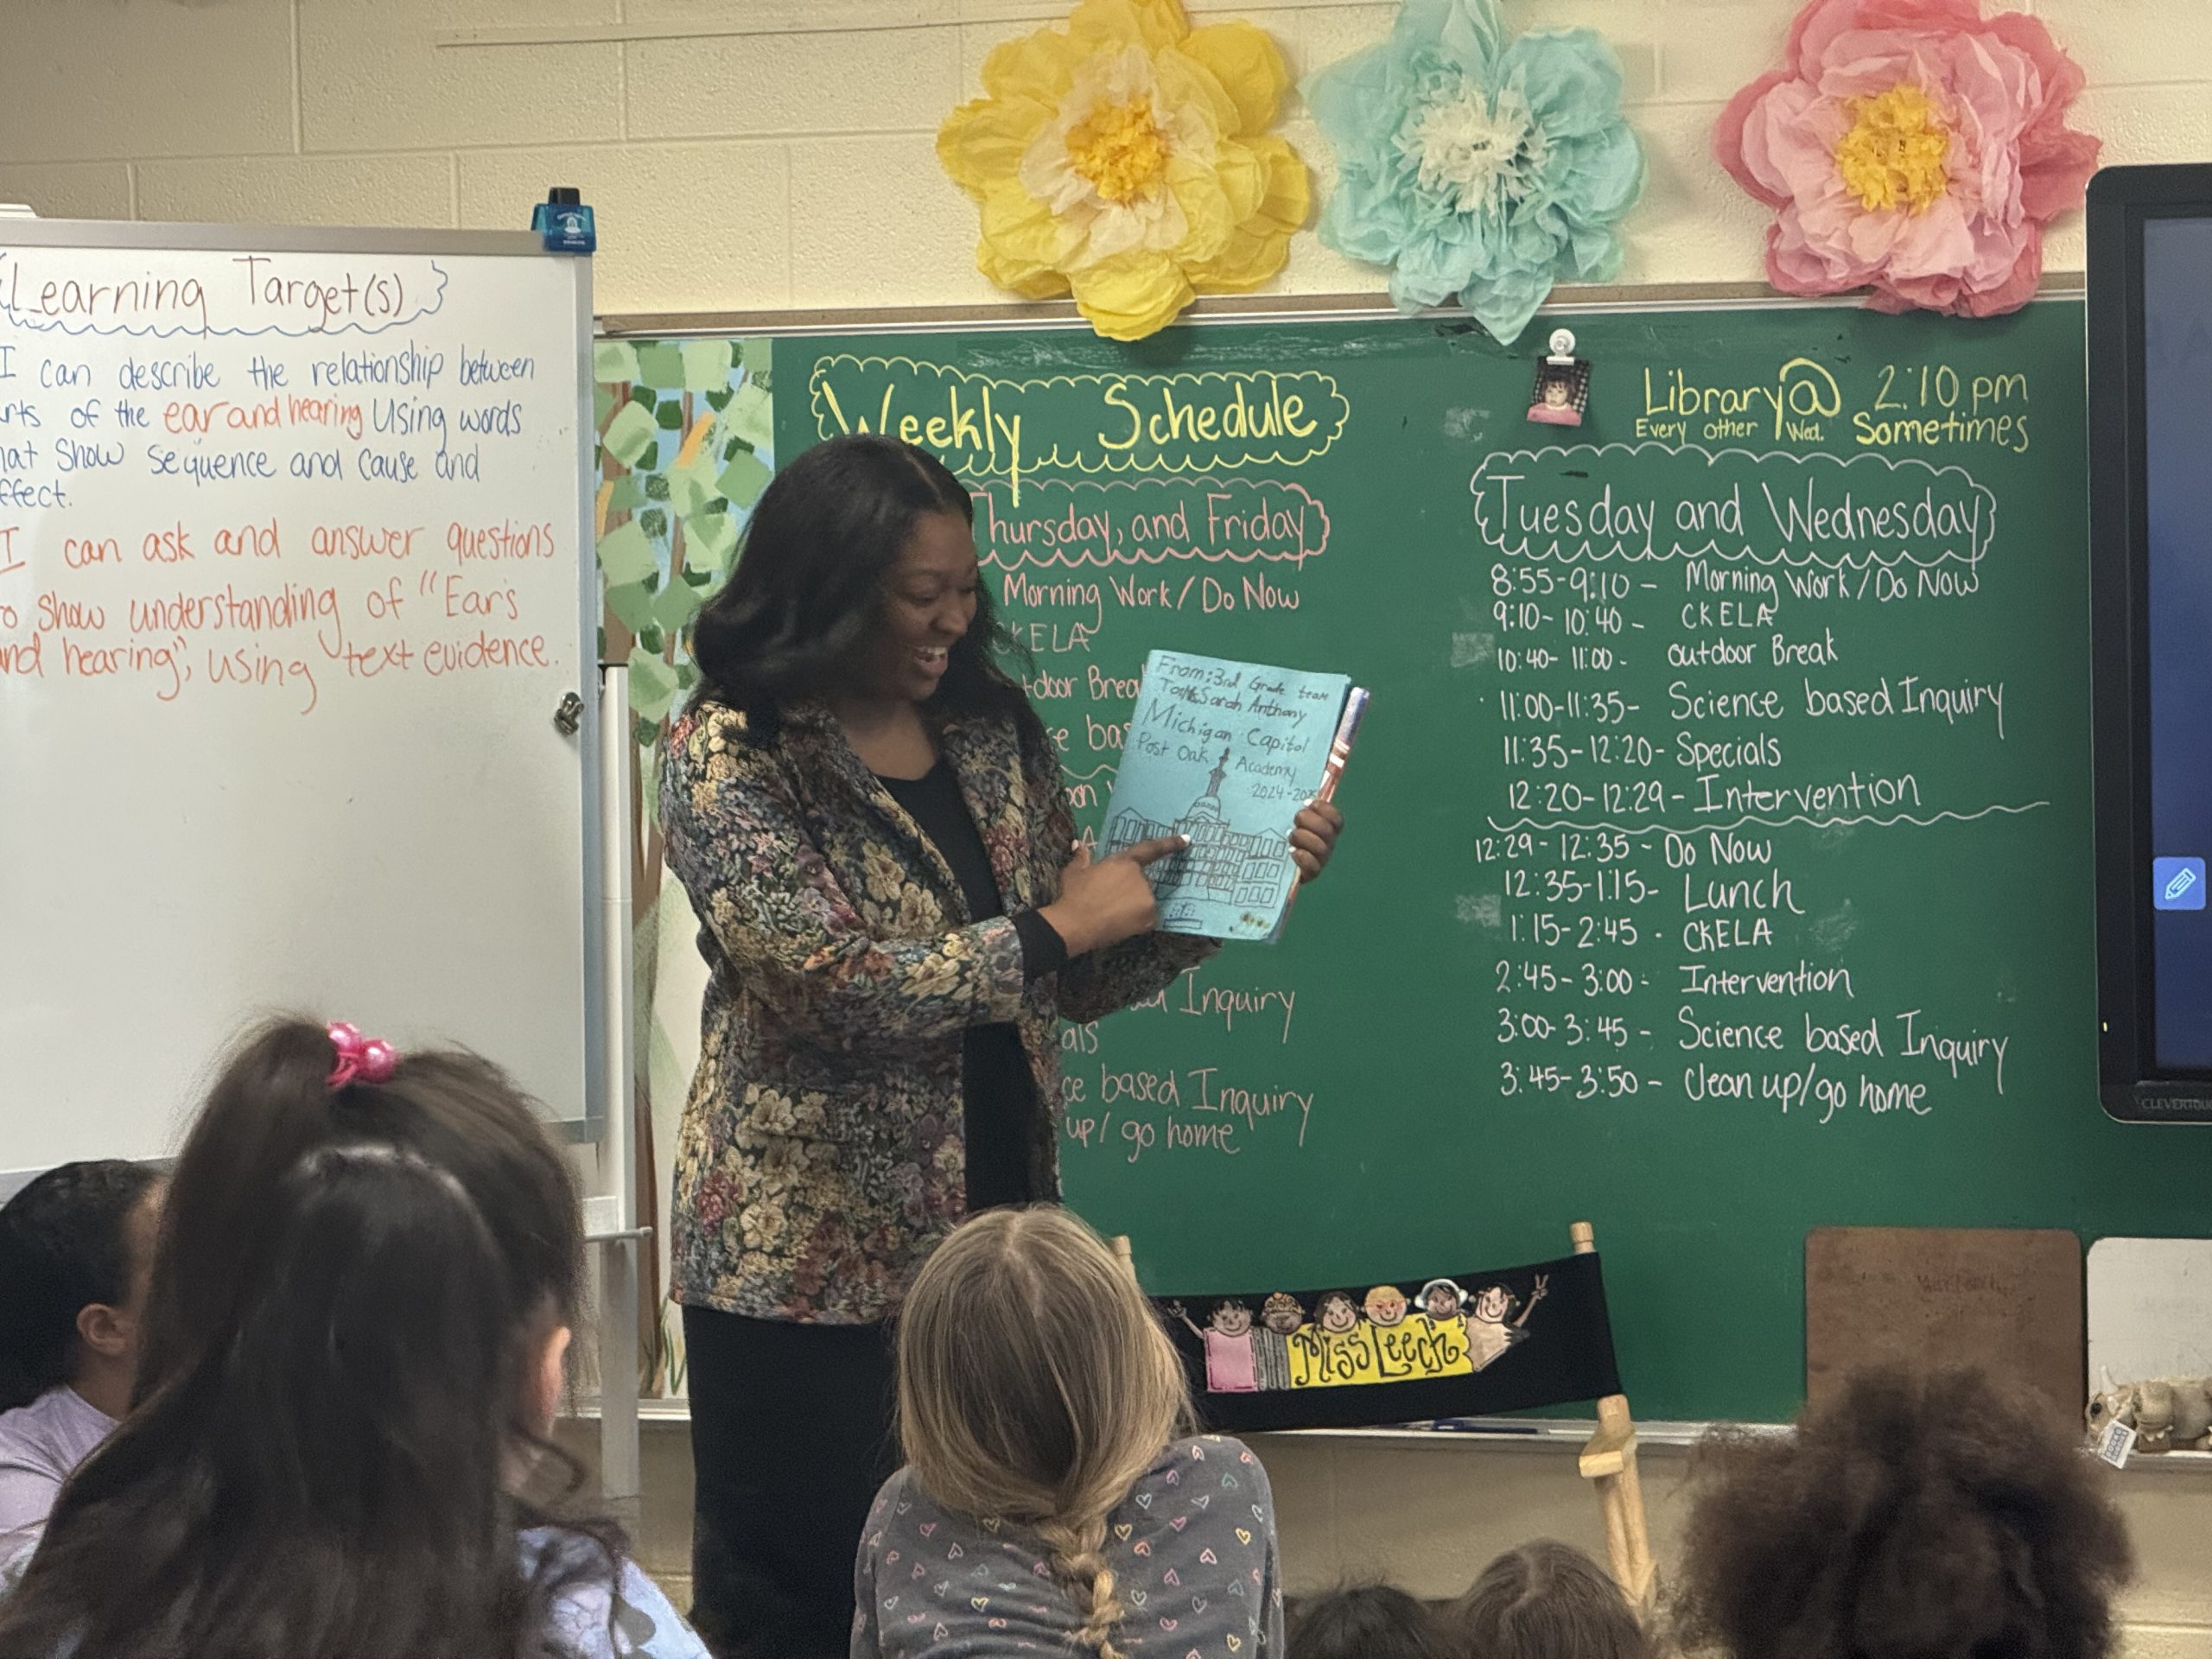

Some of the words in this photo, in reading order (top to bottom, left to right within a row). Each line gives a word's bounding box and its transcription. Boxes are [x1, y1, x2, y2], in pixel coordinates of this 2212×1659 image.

[10, 263, 207, 338] Learning
[0, 346, 16, 378] I
[40, 359, 91, 389] can
[118, 352, 221, 391] describe
[246, 353, 289, 389] the
[311, 340, 444, 391] relationship
[459, 344, 535, 381] between
[1876, 365, 1956, 411] 2:10
[1973, 373, 2027, 411] pm
[0, 402, 41, 429] rts
[71, 399, 101, 429] of
[115, 398, 151, 428] the
[163, 402, 226, 433] ear
[227, 397, 281, 433] and
[289, 393, 364, 441] hearing
[459, 400, 522, 434] words
[822, 381, 1022, 508] Weekly
[1098, 378, 1319, 450] Schedule
[1636, 419, 1686, 443] Every
[1704, 418, 1758, 440] other
[1853, 411, 2029, 452] Sometimes
[290, 445, 340, 477] and
[435, 445, 480, 481] and
[0, 478, 73, 508] ffect.
[0, 527, 25, 570] I
[64, 535, 122, 569] can
[143, 521, 195, 562] ask
[214, 518, 282, 558] and
[311, 522, 426, 559] answer
[447, 519, 554, 563] questions
[1130, 500, 1191, 544] and
[1207, 493, 1306, 571] Friday
[1486, 475, 1654, 561] Tuesday
[1676, 484, 1744, 535] and
[1762, 478, 1980, 570] Wednesday
[1003, 572, 1103, 633] Morning
[1243, 574, 1299, 609] Now
[1686, 560, 1778, 613] Morning
[1917, 569, 1979, 596] Now
[130, 583, 342, 658] understanding
[366, 576, 404, 620] of
[1772, 628, 1838, 666] Break
[208, 650, 318, 715] using
[346, 636, 413, 678] text
[423, 634, 560, 675] evidence.
[1021, 669, 1077, 700] tdoor
[1088, 664, 1147, 700] Brea
[1141, 698, 1230, 747] Michigan
[1248, 728, 1309, 755] Capitol
[1668, 682, 1783, 721] Science
[1805, 677, 1894, 716] based
[1898, 677, 2005, 740] Inquiry
[1137, 731, 1171, 756] Post
[1178, 746, 1209, 763] Oak
[1236, 757, 1296, 786] Academy
[1676, 730, 1782, 772] Specials
[1694, 772, 1921, 816] Intervention
[1664, 833, 1696, 868] Do
[1712, 835, 1772, 864] Now
[1684, 868, 1804, 914] Lunch
[1179, 966, 1295, 1044] Inquiry
[1680, 963, 1853, 1000] Intervention
[1679, 1007, 1783, 1051] Science
[1806, 1012, 1884, 1058] based
[1897, 1009, 2008, 1094] Inquiry
[1102, 1063, 1179, 1107] based
[1188, 1068, 1313, 1147] Inquiry
[1859, 1074, 1931, 1115] home
[1168, 1116, 1240, 1154] home
[1294, 1328, 1370, 1385] Miss
[1371, 1318, 1459, 1377] Leech
